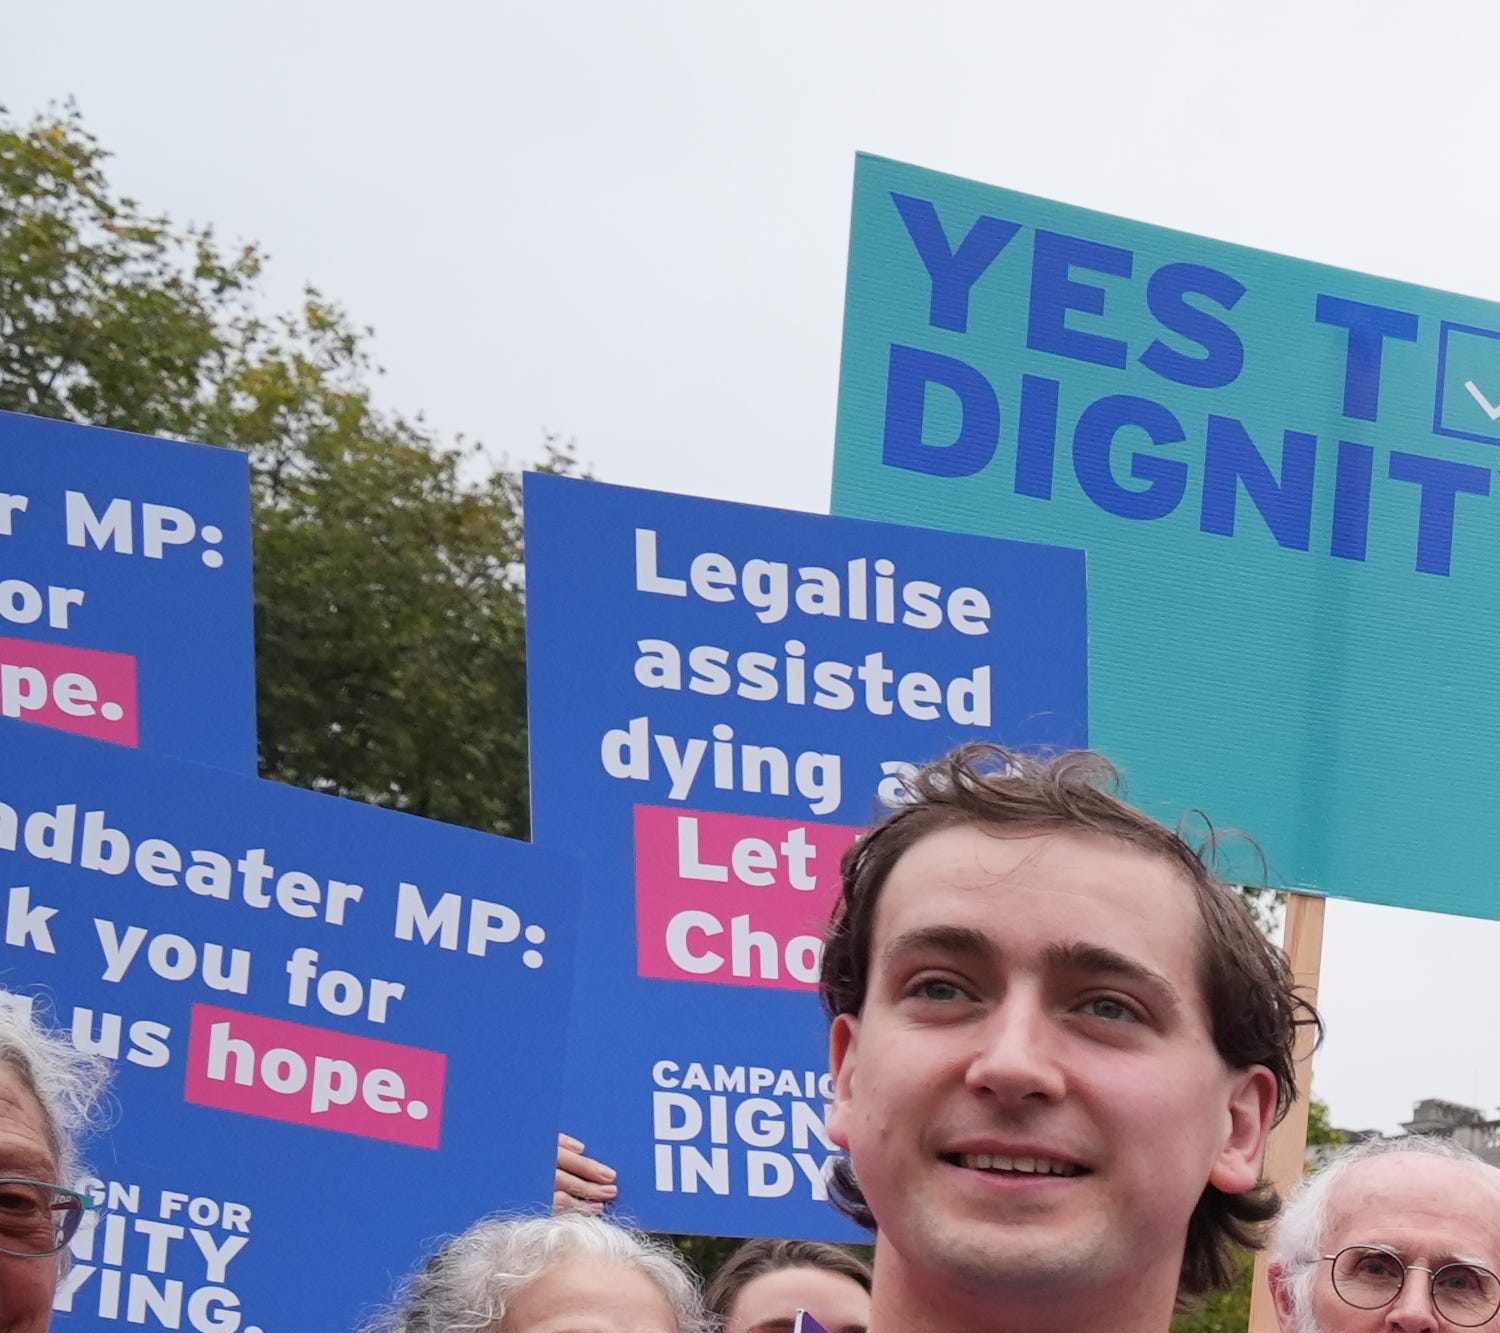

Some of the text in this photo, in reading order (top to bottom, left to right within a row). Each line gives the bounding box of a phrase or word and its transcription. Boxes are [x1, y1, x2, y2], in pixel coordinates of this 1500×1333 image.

[890, 192, 1247, 388] YES
[68, 493, 223, 567] MP:
[0, 579, 85, 630] or
[637, 530, 990, 634] Legalise
[0, 661, 124, 722] pe.
[636, 640, 990, 726] assisted
[603, 718, 840, 814] dying
[679, 817, 816, 890] Let
[396, 884, 545, 967] MP:
[96, 920, 250, 993] you
[288, 949, 404, 1022] for
[72, 1007, 428, 1119] us hope.
[652, 1060, 835, 1099] CAMPAI
[653, 1091, 842, 1151] DIGN
[653, 1143, 730, 1196] IN
[161, 1192, 251, 1232] FOR
